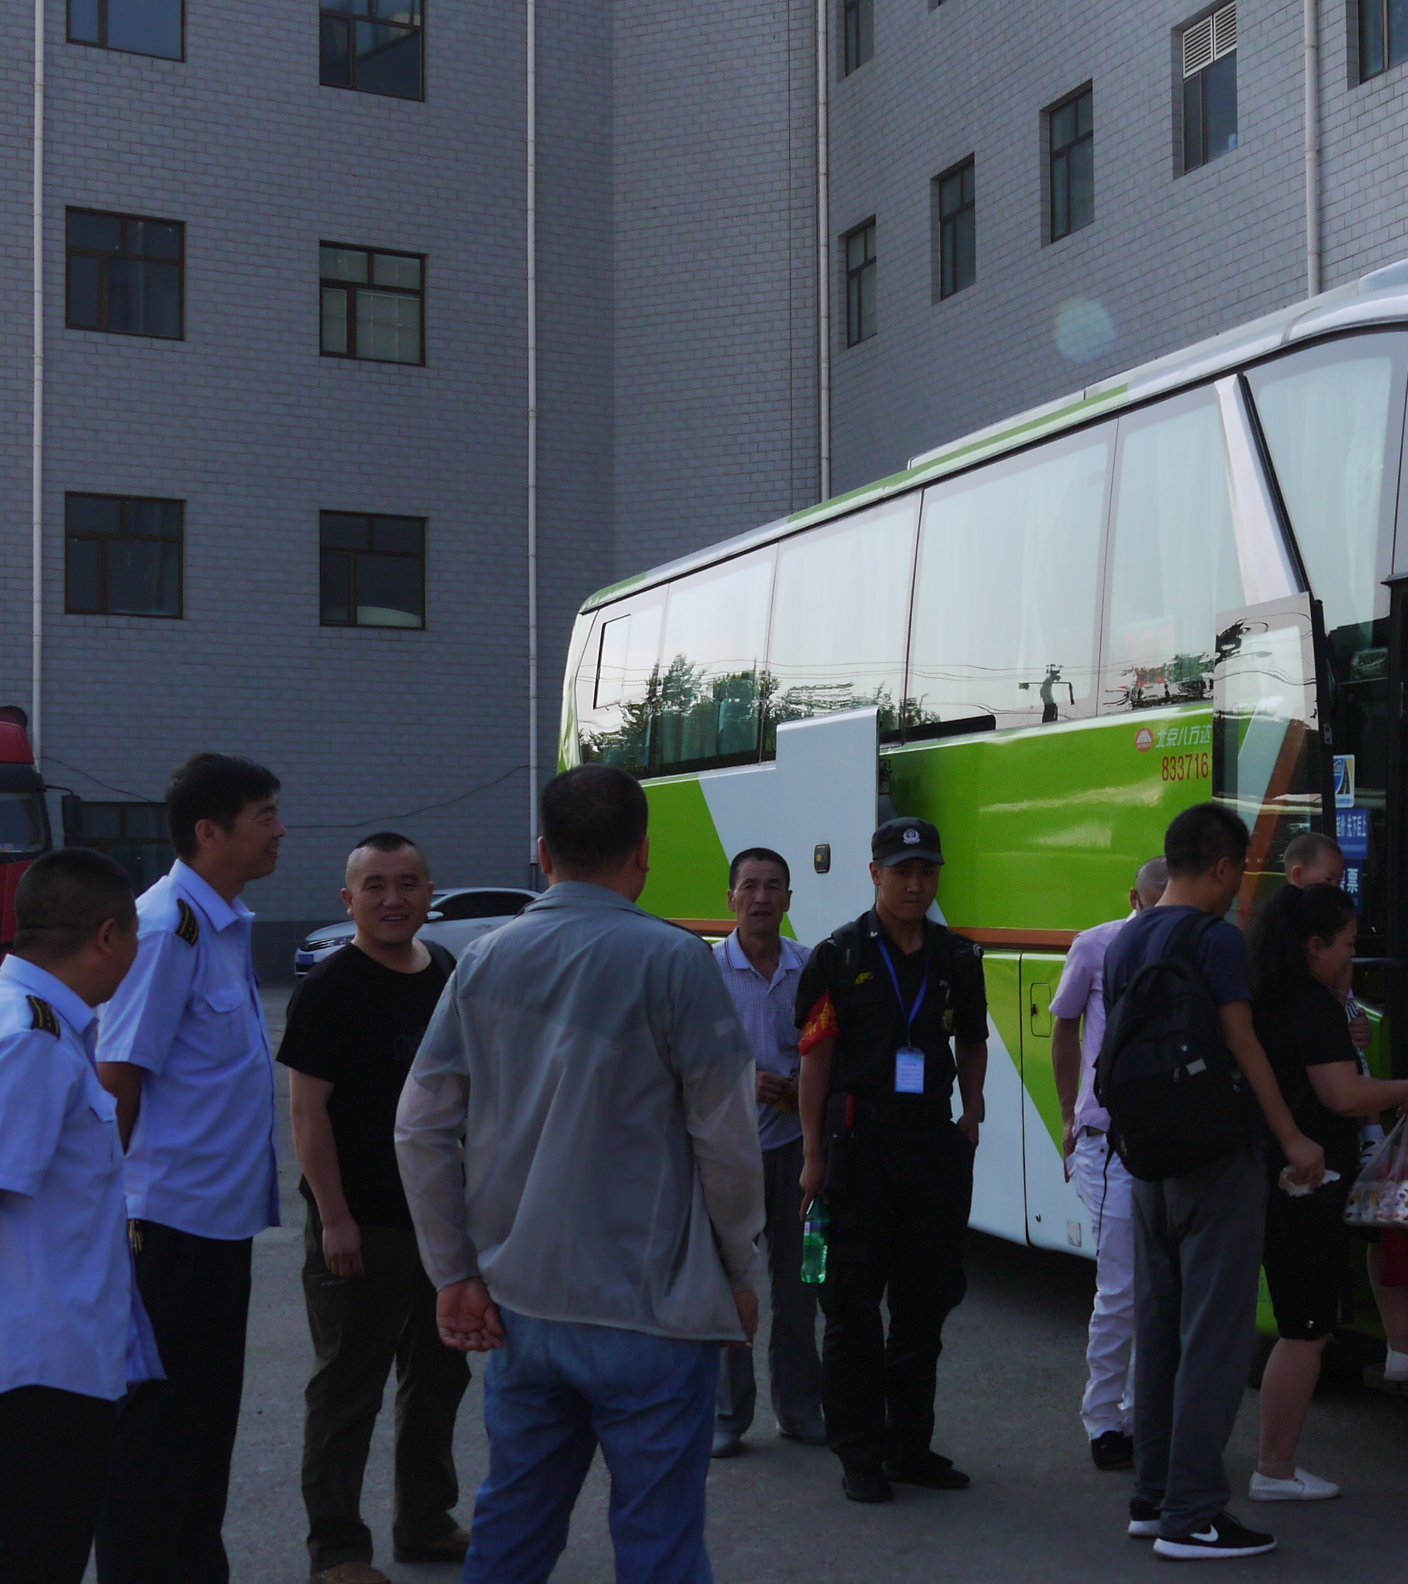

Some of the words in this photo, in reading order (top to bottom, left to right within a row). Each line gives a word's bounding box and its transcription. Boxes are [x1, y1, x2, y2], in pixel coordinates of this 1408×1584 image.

[1155, 724, 1213, 749] 北京八方达
[1161, 752, 1209, 782] 833716
